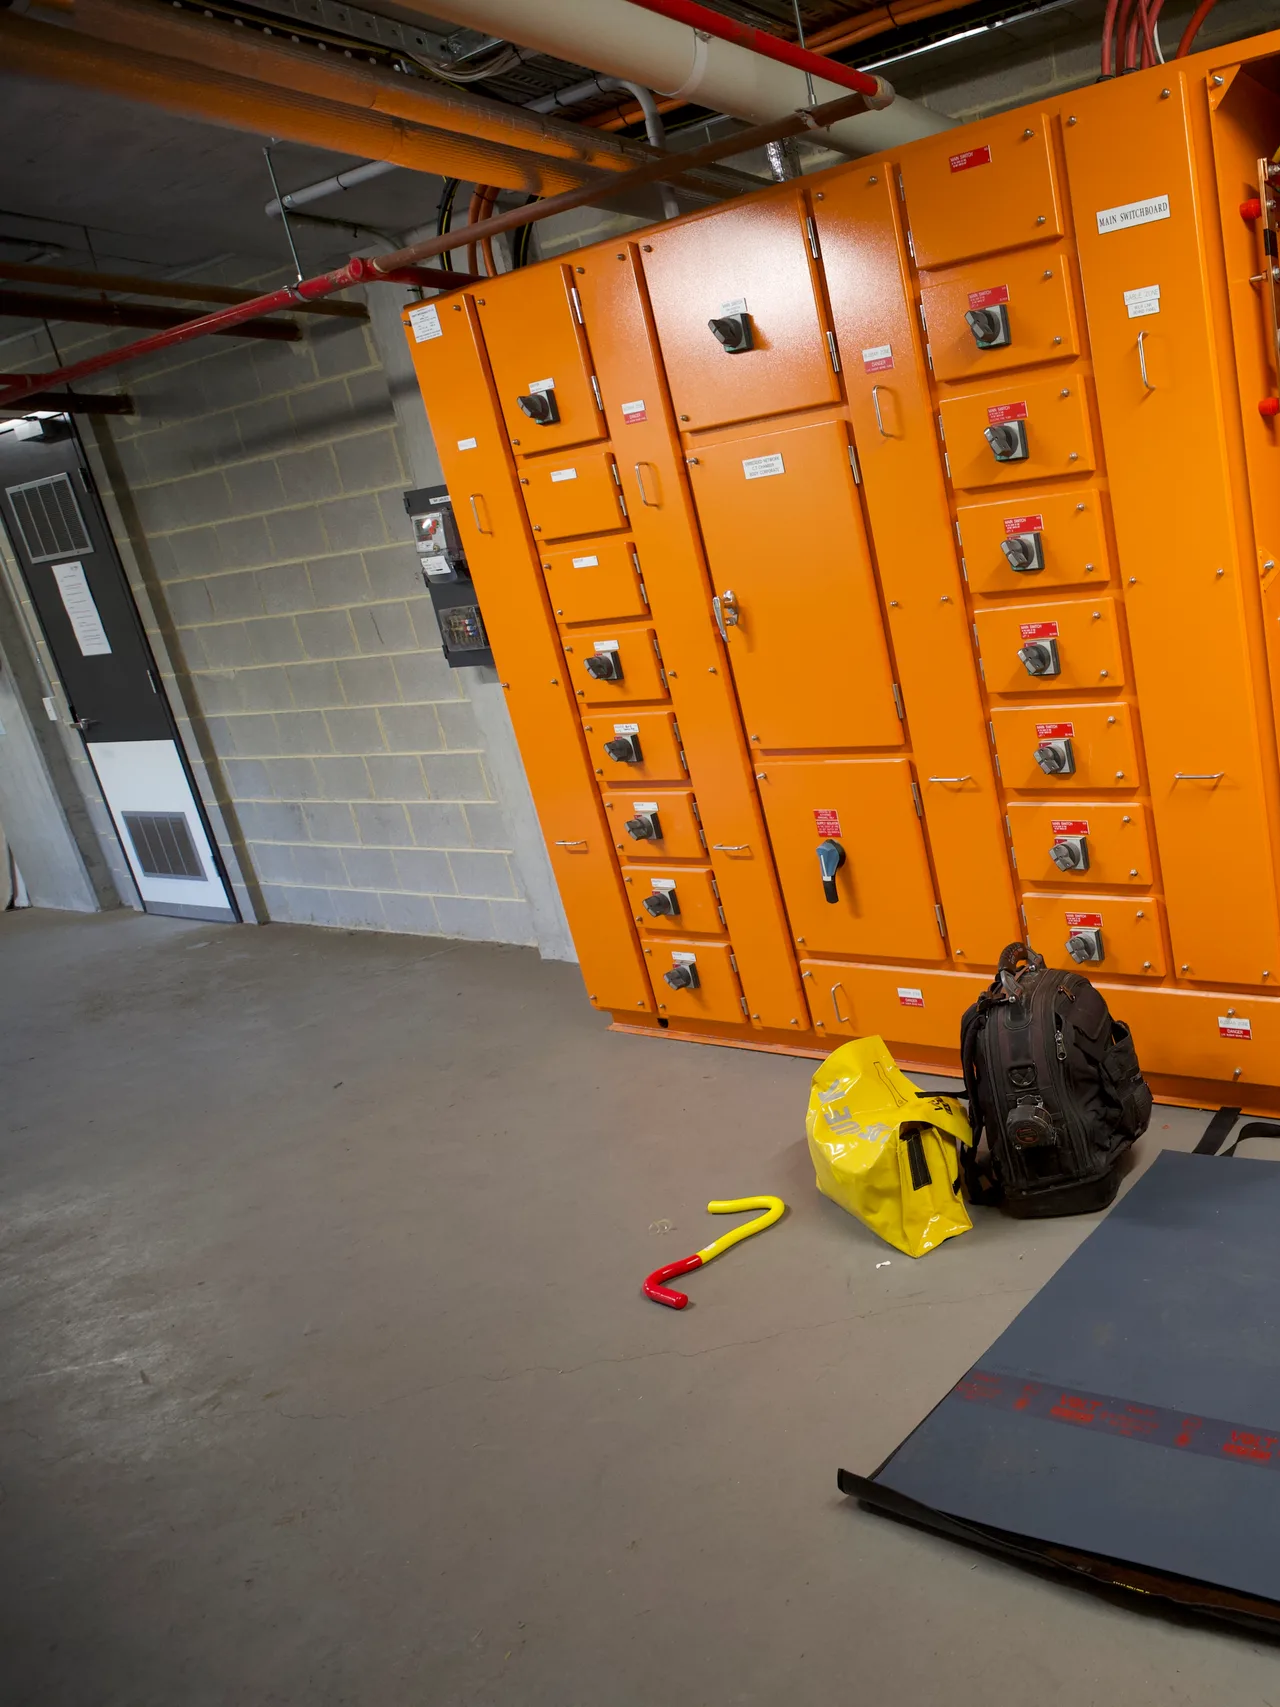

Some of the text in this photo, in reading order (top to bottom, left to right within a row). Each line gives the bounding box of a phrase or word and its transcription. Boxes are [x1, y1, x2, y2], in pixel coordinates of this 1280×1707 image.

[1099, 202, 1168, 227] MAIN SWITCHBOARD
[1231, 1429, 1279, 1449] VOLT
